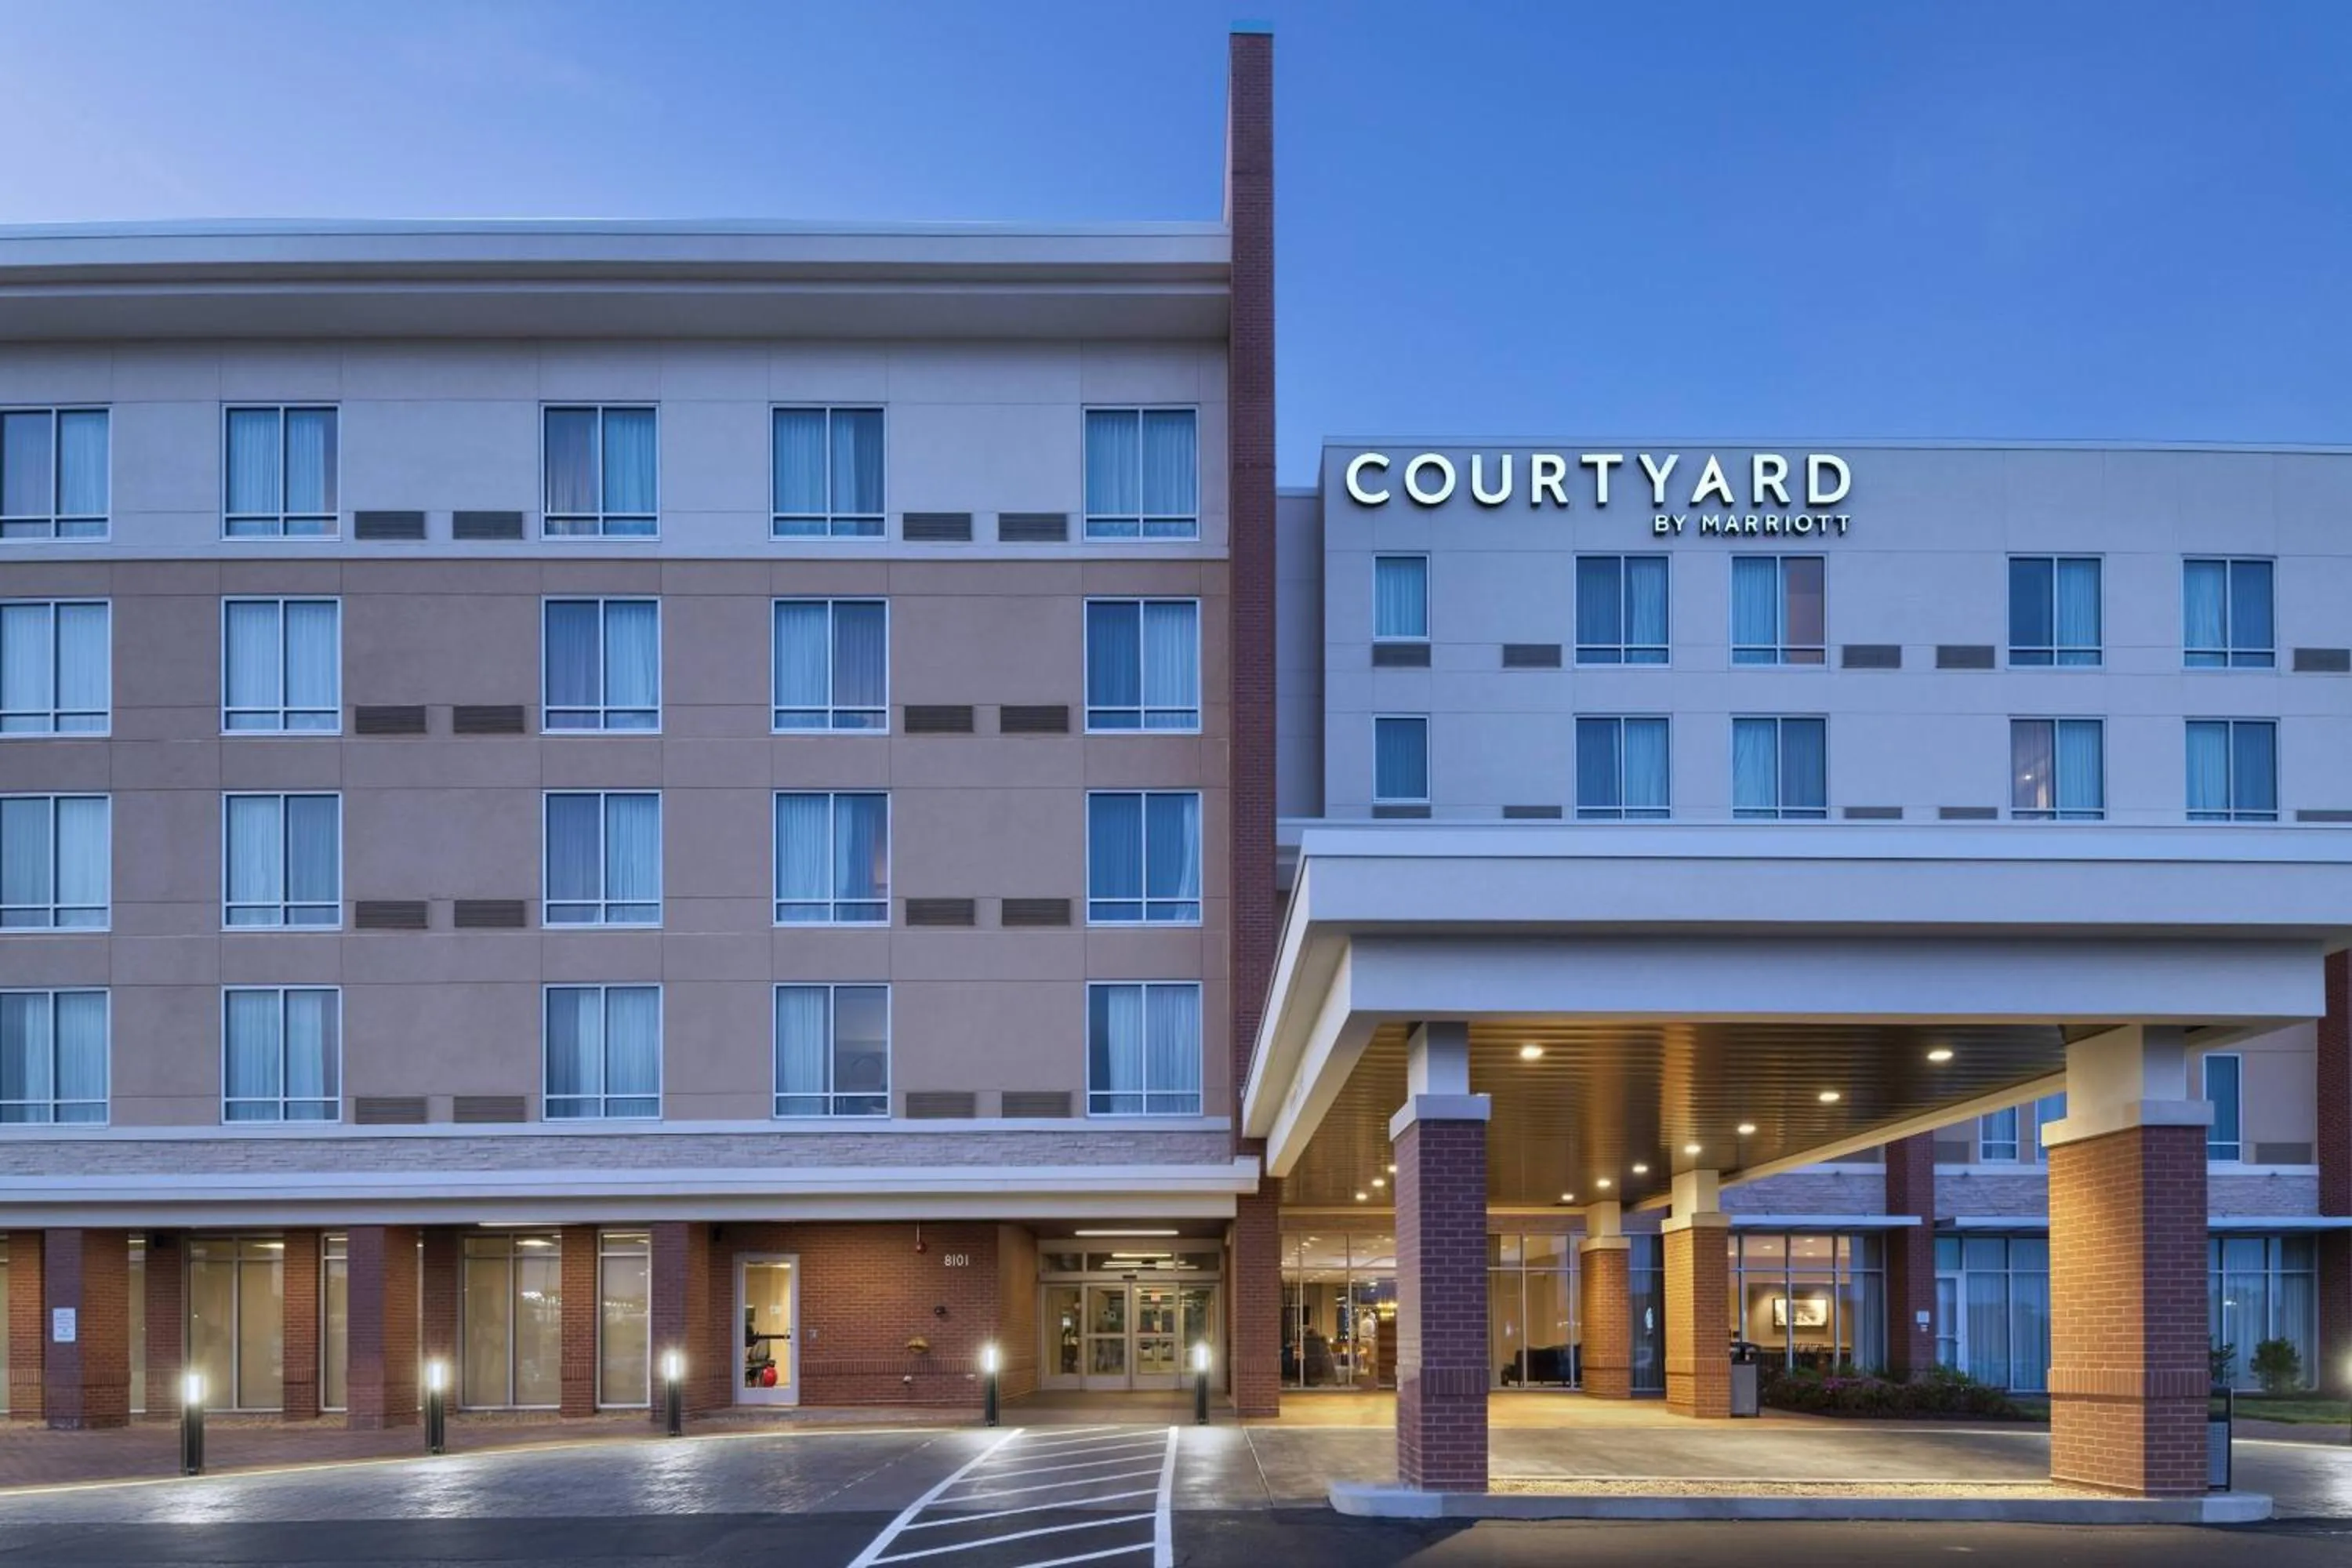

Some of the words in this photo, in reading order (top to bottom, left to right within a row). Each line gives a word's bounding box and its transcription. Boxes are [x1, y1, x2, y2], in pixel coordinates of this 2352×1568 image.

[1345, 452, 1851, 504] COURTYARD
[1654, 514, 1686, 532] BY
[1701, 514, 1850, 532] MARRIOTT
[944, 1254, 968, 1267] 8101
